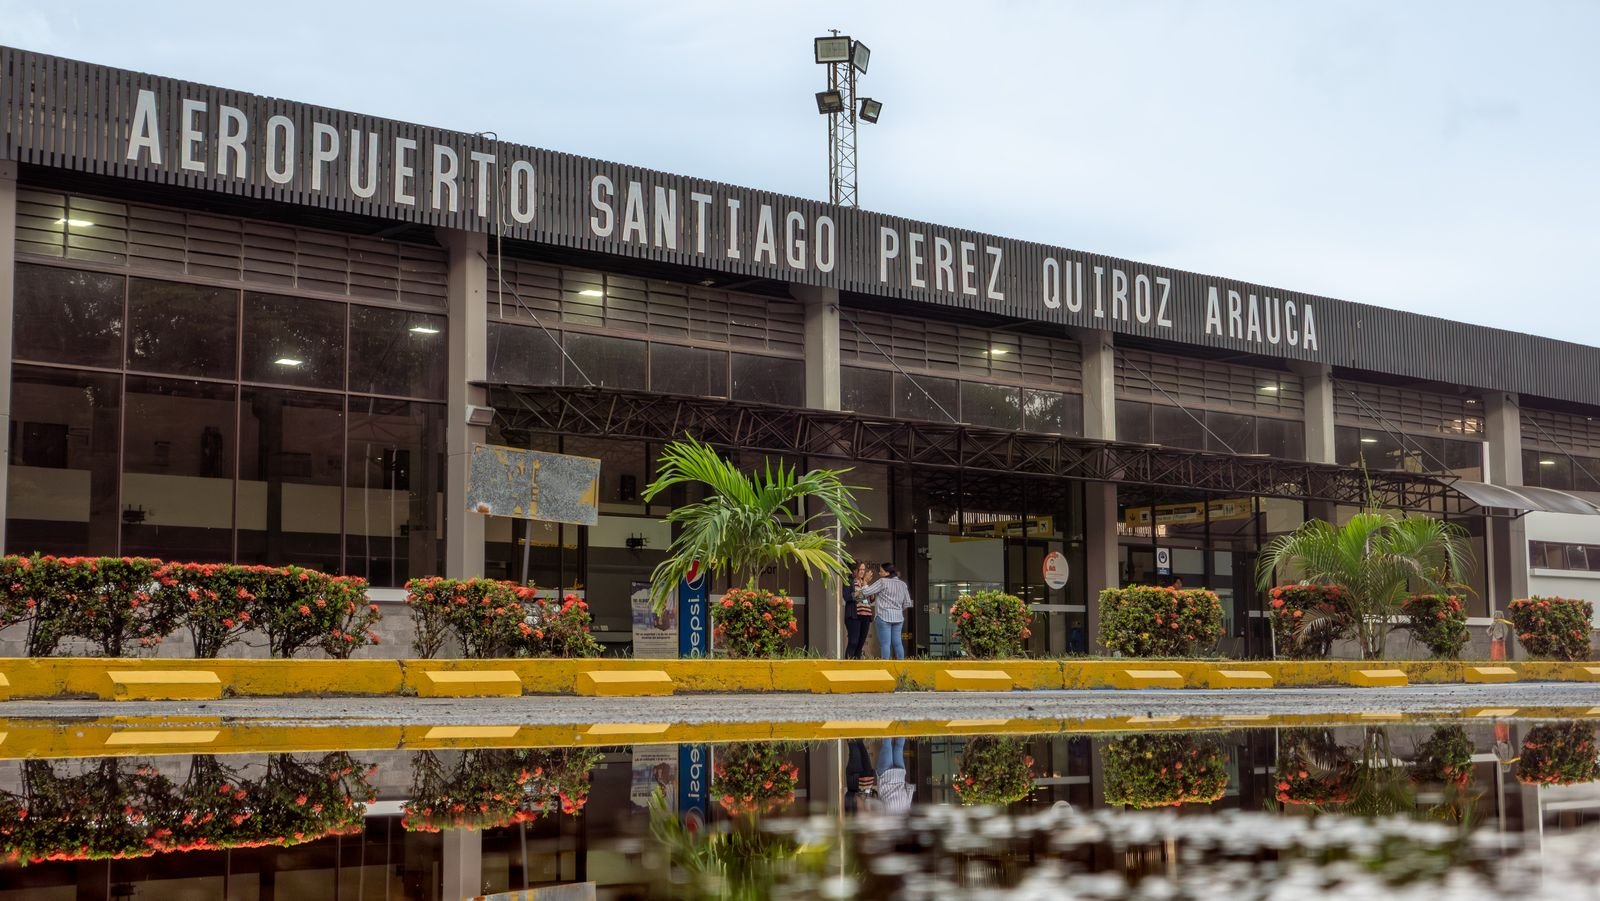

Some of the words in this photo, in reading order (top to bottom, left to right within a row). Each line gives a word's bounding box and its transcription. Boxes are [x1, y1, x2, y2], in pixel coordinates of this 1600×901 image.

[125, 88, 537, 226] AEROPUERTO
[590, 174, 838, 274] SANTIAGO
[880, 226, 1005, 301] PEREZ
[1042, 257, 1174, 329] QUIROZ
[1205, 286, 1318, 351] ARAUCA
